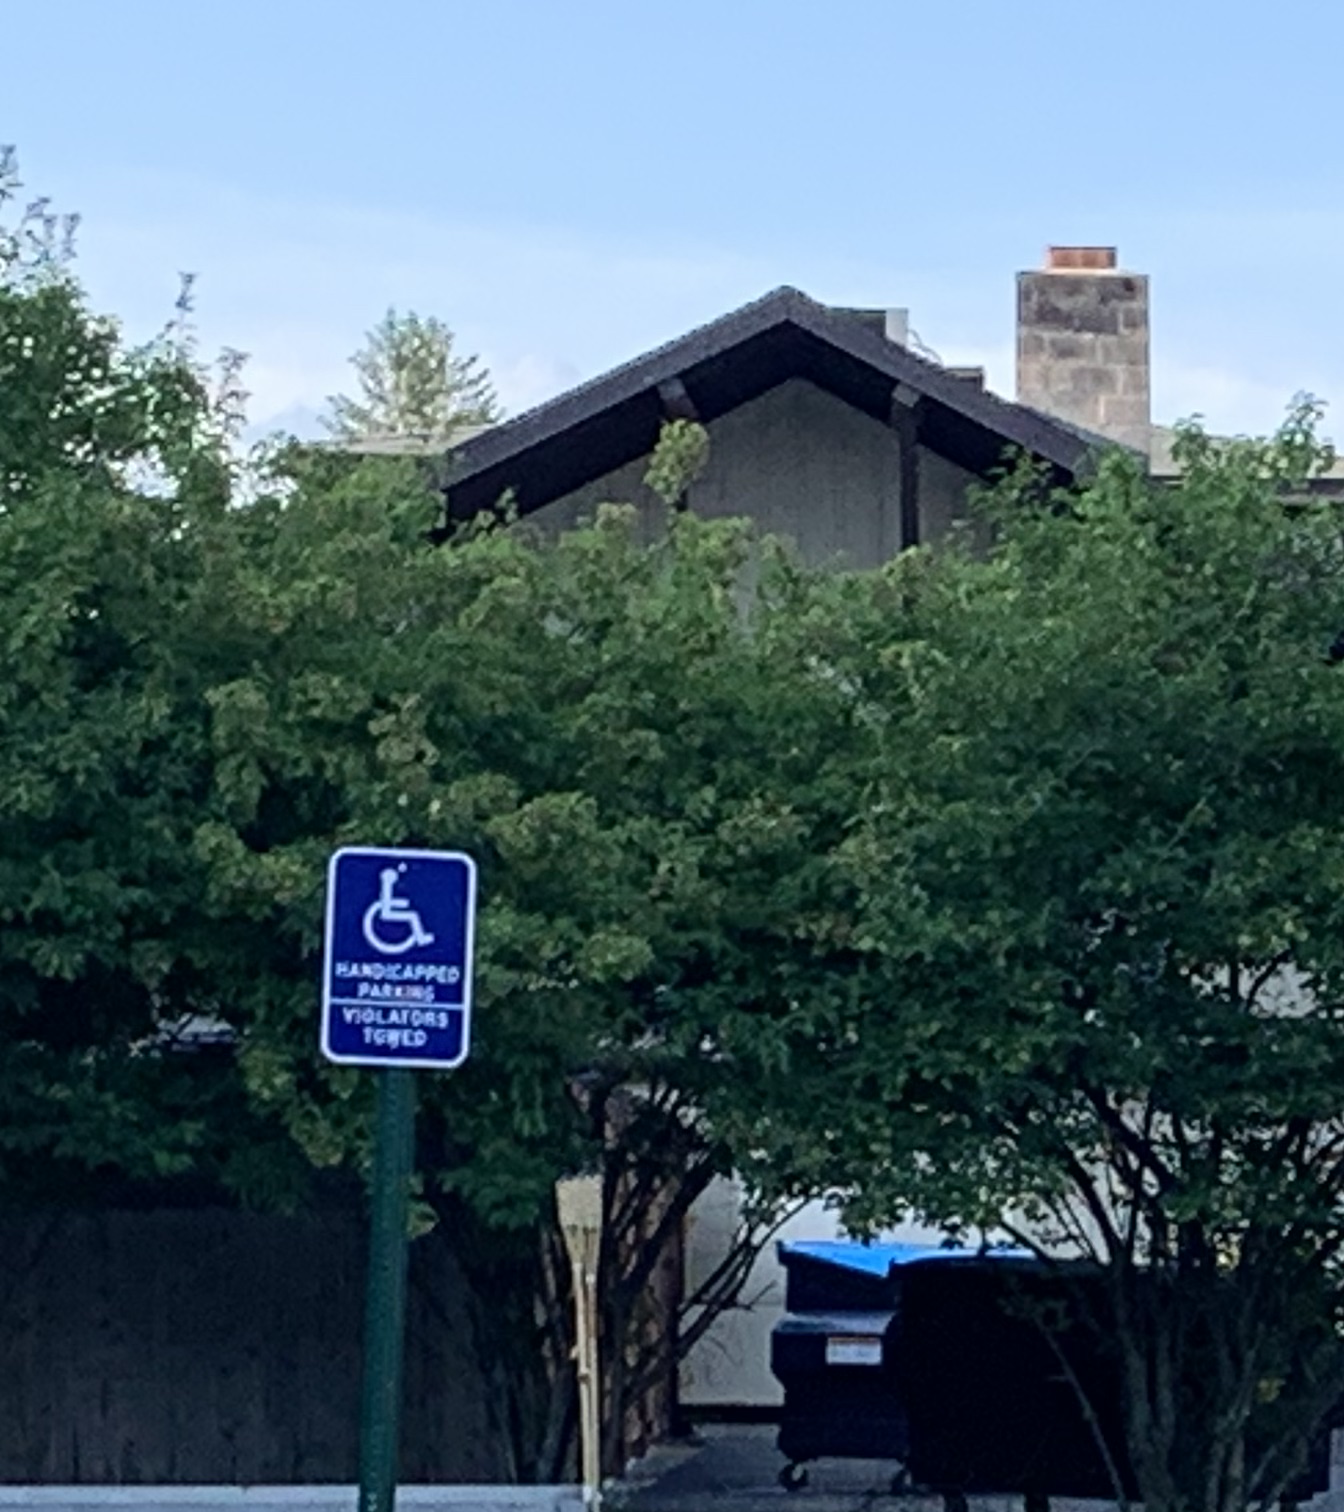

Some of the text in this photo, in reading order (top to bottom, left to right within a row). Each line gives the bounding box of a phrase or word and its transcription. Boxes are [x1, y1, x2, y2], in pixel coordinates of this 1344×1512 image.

[335, 962, 460, 984] HANDICAPPED
[358, 981, 435, 1002] PARKING
[343, 1006, 449, 1029] VIOLATORS
[363, 1026, 428, 1049] TOWED
